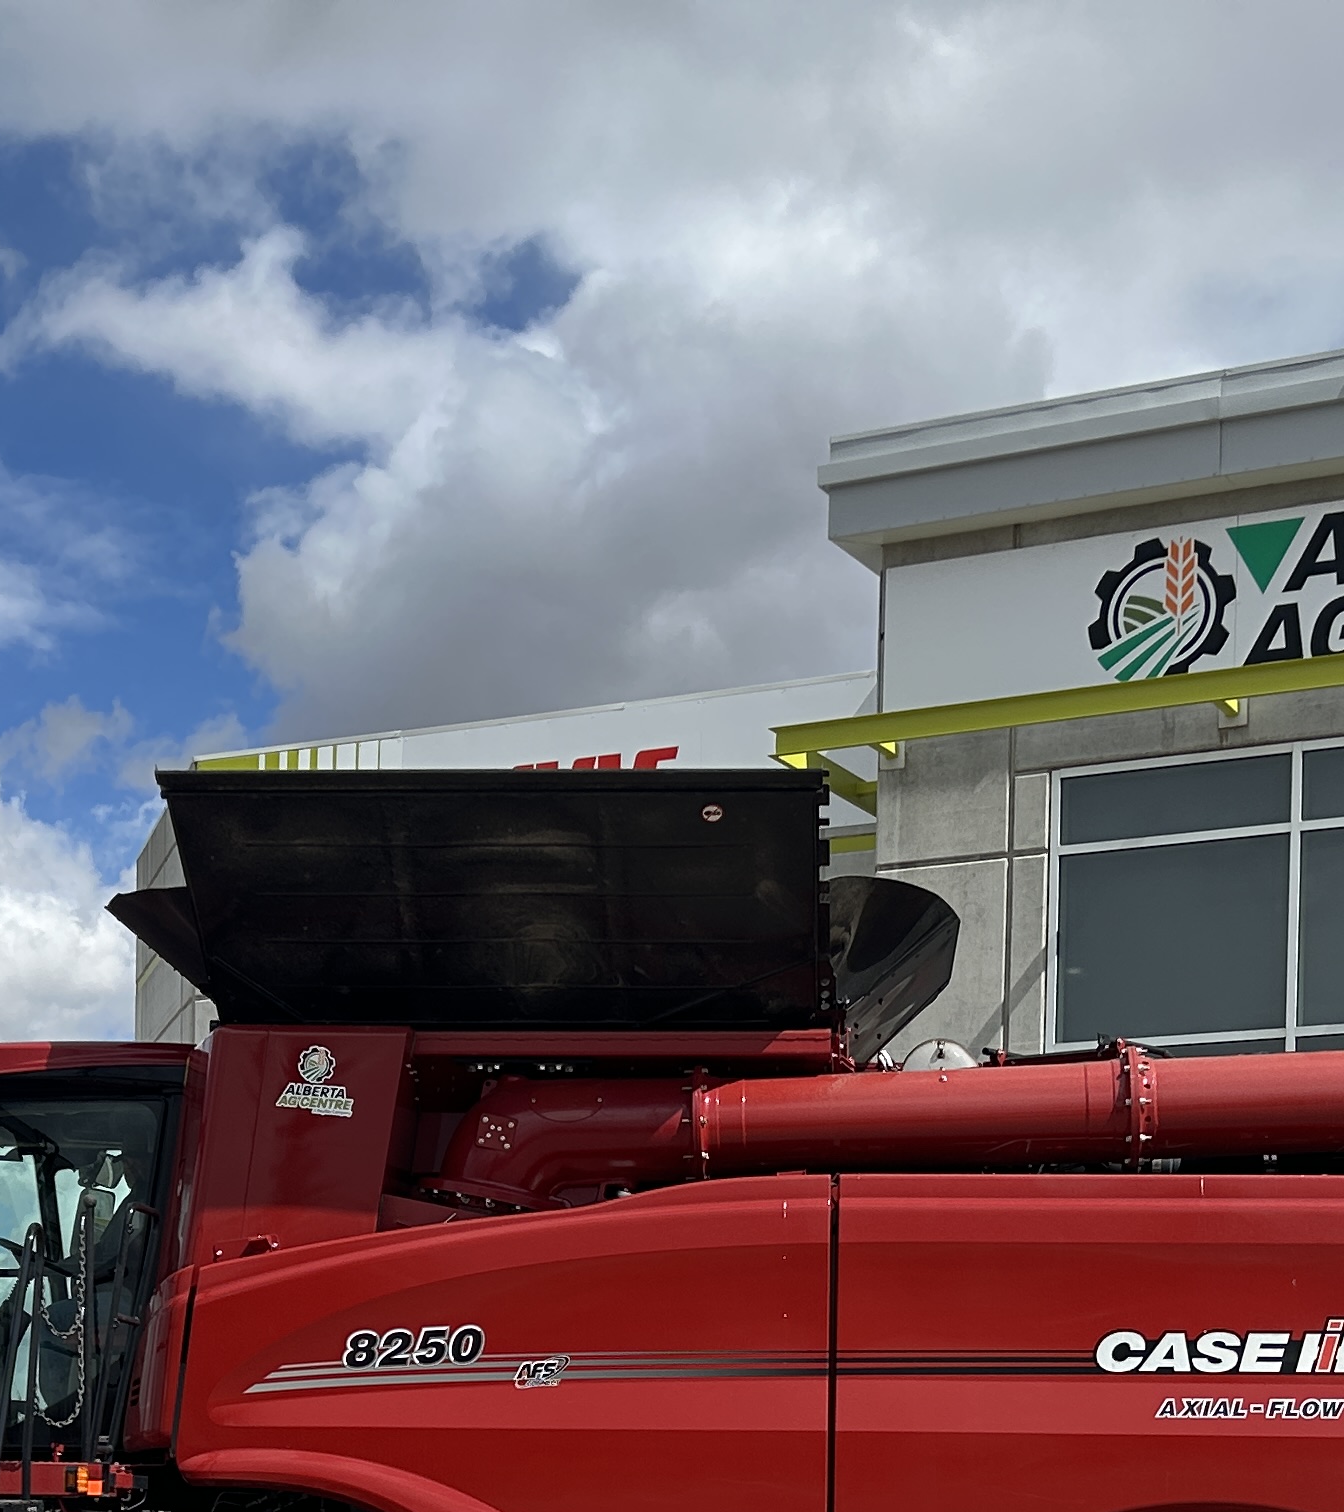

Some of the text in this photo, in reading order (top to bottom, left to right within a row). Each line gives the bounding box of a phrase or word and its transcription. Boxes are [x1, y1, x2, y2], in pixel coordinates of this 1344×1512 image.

[284, 1085, 345, 1099] ALBERTA
[278, 1096, 352, 1110] AG CENTRE
[343, 1324, 485, 1370] 8250
[1096, 1331, 1290, 1373] CASE
[515, 1360, 559, 1380] AFS
